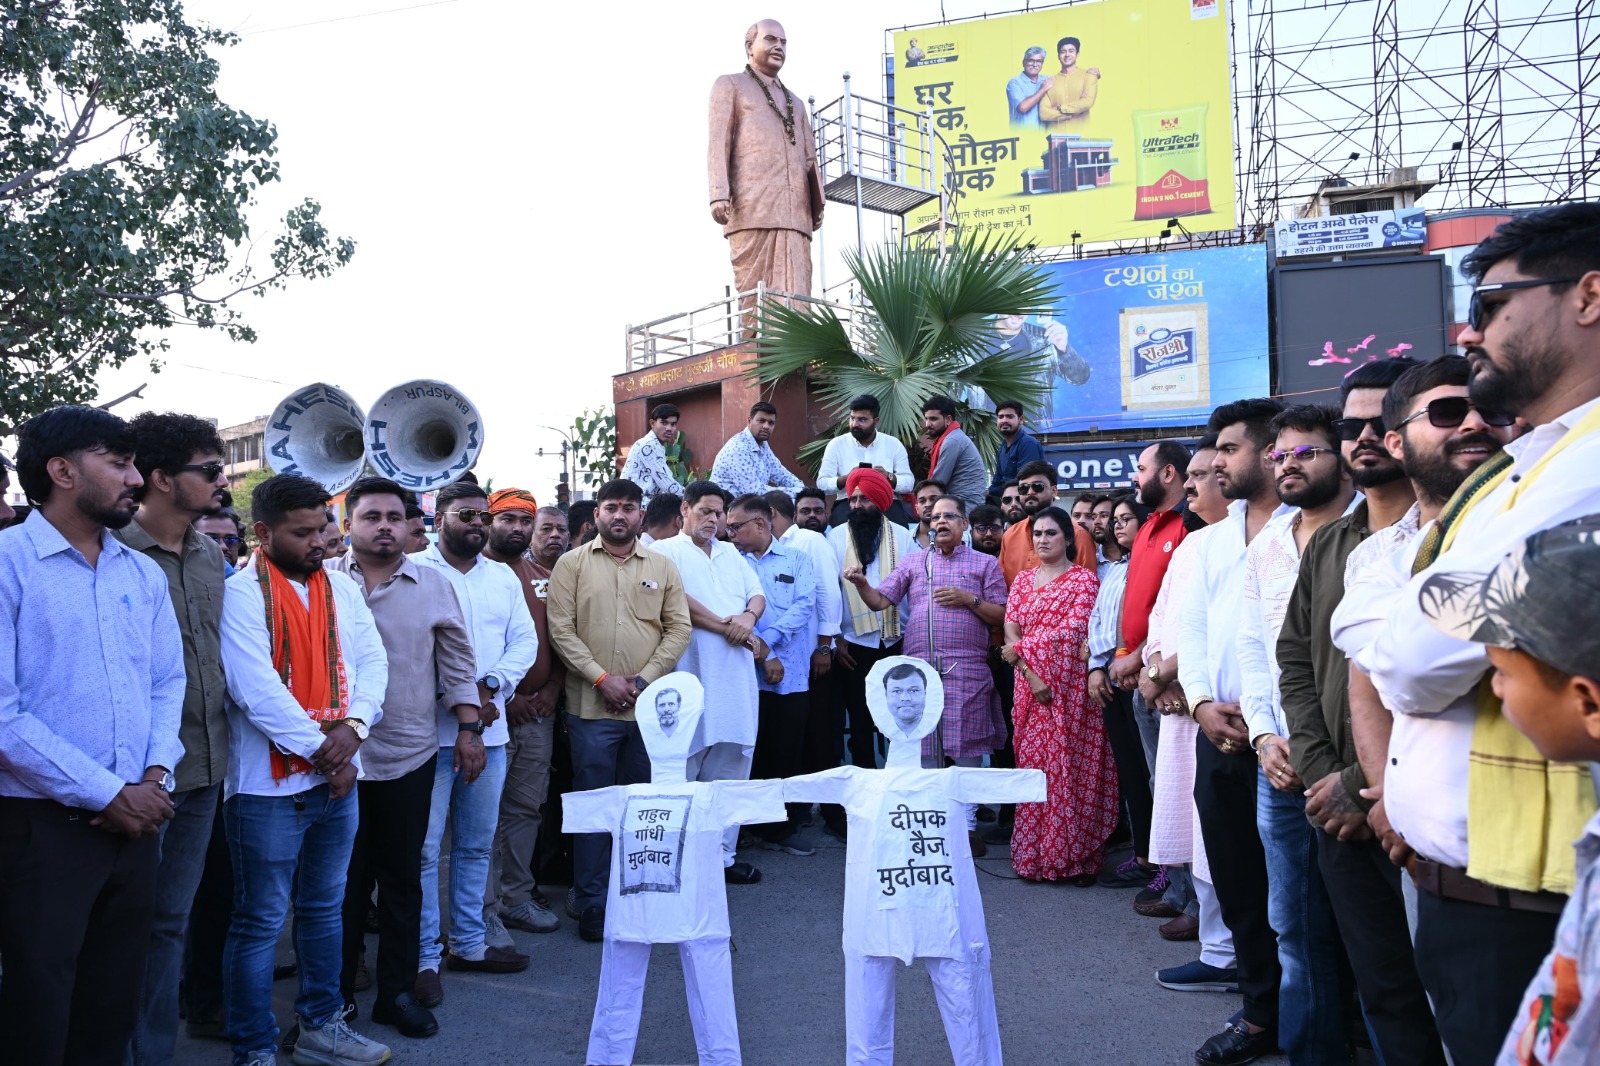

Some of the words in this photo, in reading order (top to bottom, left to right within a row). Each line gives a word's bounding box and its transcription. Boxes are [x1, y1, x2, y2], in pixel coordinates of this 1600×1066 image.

[913, 81, 954, 105] घर
[1142, 132, 1199, 148] UltraTech
[946, 166, 996, 199] एक
[1141, 194, 1164, 203] INDIA'S
[1180, 190, 1205, 199] CEMENT
[997, 203, 1016, 215] करने
[1018, 204, 1031, 213] का
[1003, 219, 1014, 229] का
[1288, 221, 1319, 233] होटल
[1321, 216, 1346, 229] अम्बे
[1347, 214, 1379, 226] पैलेस
[1294, 244, 1314, 254] ठहरने
[1315, 244, 1326, 253] की
[1327, 243, 1344, 252] उत्तम
[1345, 241, 1374, 250] व्यवस्था
[1103, 264, 1169, 287] टशन
[1171, 267, 1194, 281] का
[1146, 280, 1205, 301] जश्न
[1141, 336, 1185, 362] राजश्री
[717, 351, 738, 369] चौक
[404, 386, 470, 415] BILASPUR
[370, 420, 479, 488] MAHESH
[638, 809, 672, 823] राहुल
[889, 804, 946, 830] दीपक
[635, 825, 666, 841] गांधी
[628, 845, 673, 870] मुर्दाबाद
[877, 859, 955, 896] मुर्दाबाद
